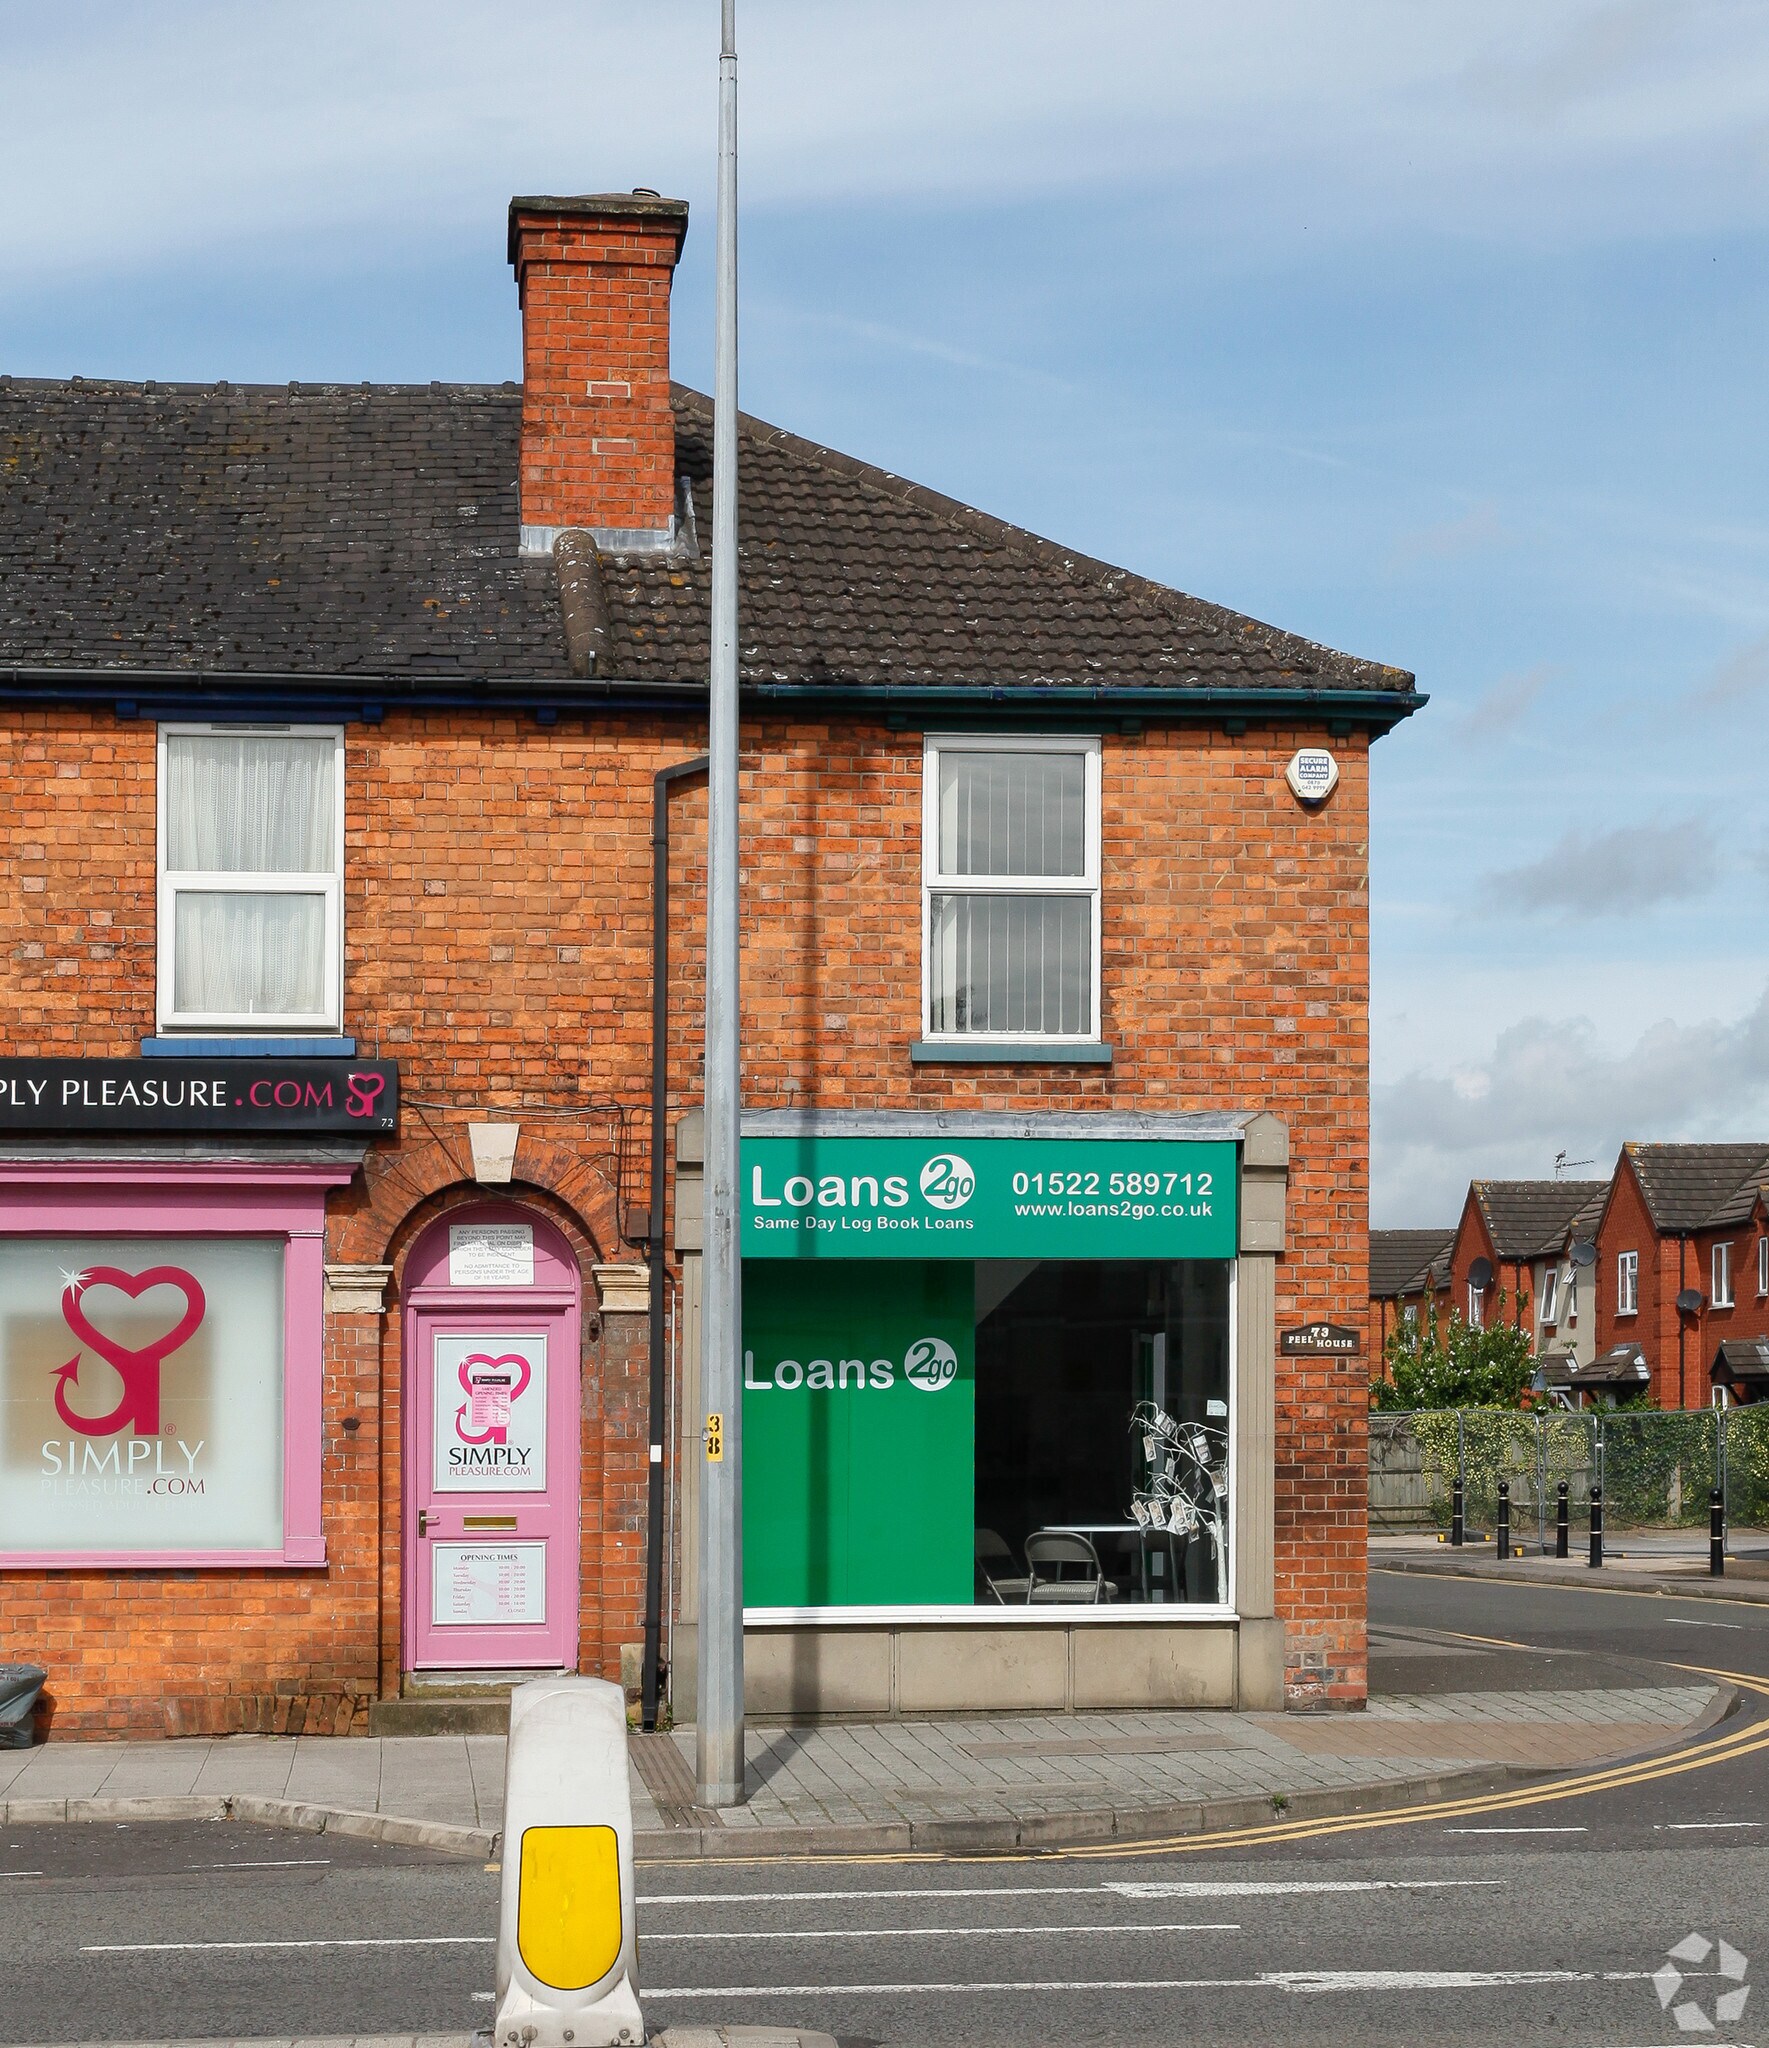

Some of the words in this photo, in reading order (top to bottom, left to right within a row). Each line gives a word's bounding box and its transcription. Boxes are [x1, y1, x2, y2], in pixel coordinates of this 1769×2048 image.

[381, 1118, 394, 1127] 72
[752, 1165, 910, 1207] Loans
[924, 1158, 974, 1204] 2go
[1012, 1172, 1100, 1196] 01522
[1109, 1172, 1213, 1196] 589712
[1014, 1201, 1213, 1220] www.loans2go.co.uk
[753, 1216, 800, 1229] Same
[805, 1216, 836, 1232] Day
[841, 1216, 872, 1232] Log
[877, 1216, 920, 1229] Book
[924, 1216, 974, 1229] Loans
[1288, 1336, 1314, 1344] PEEL
[1311, 1327, 1329, 1337] 73
[744, 1350, 894, 1390] Loans
[908, 1342, 956, 1386] 2go
[41, 1440, 205, 1476] SIMPLY
[448, 1448, 531, 1466] SIMPLY
[450, 1466, 531, 1476] PLEASURE.COM
